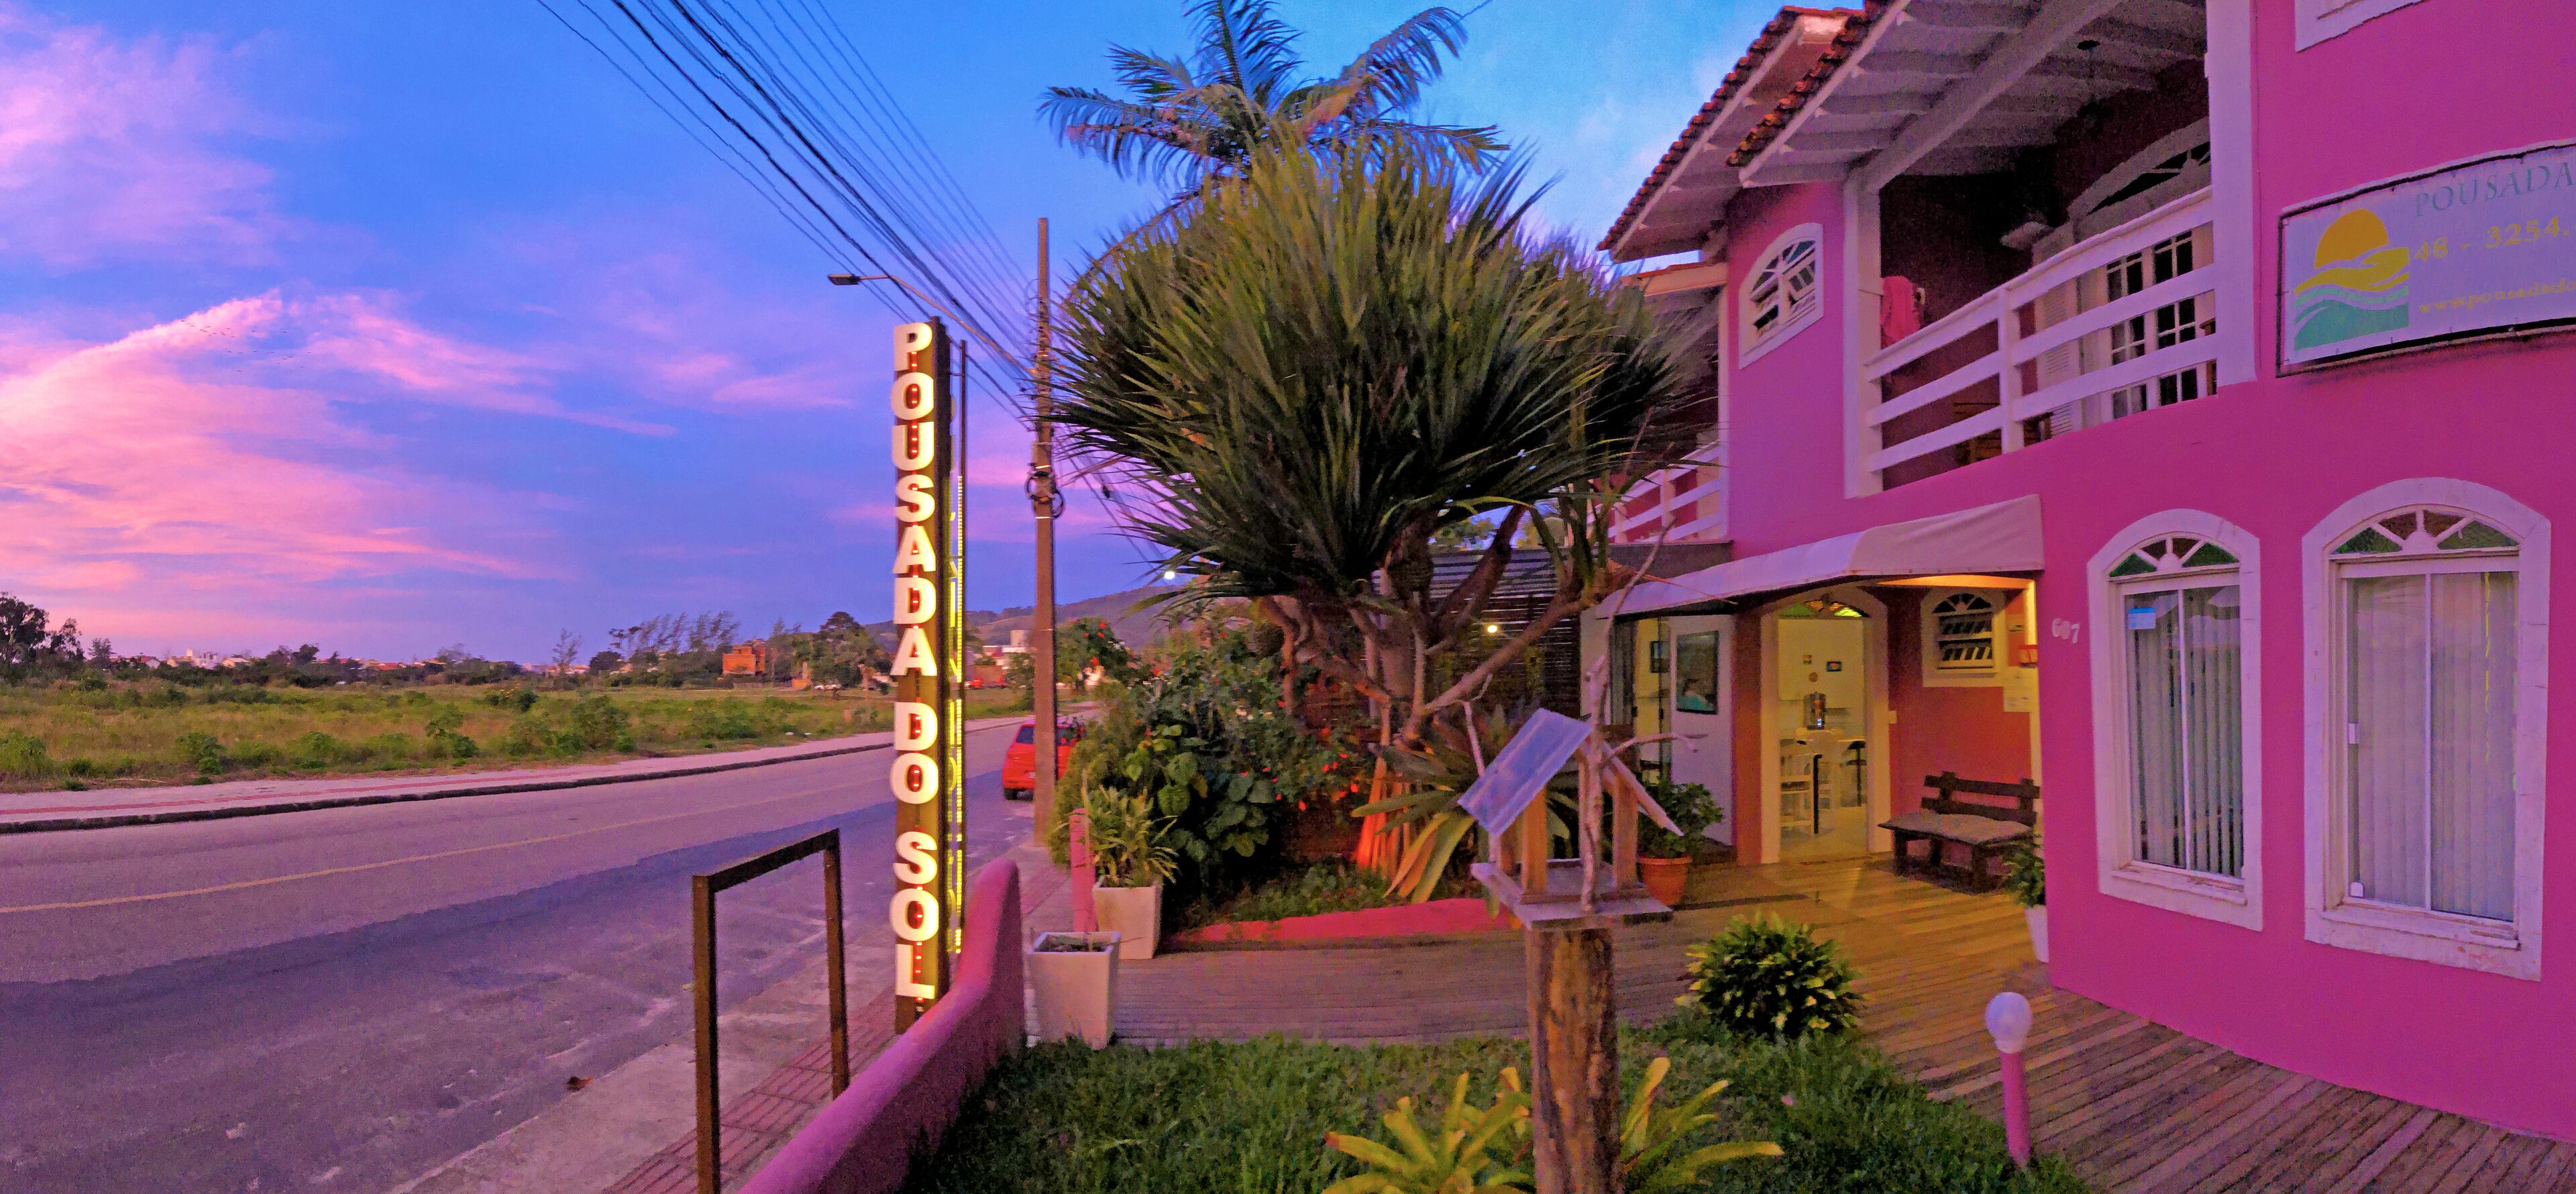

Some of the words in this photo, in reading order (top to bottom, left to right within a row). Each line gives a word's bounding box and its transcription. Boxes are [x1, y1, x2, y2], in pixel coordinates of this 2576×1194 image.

[2414, 236, 2448, 262] 48
[2485, 215, 2576, 250] 3254.
[890, 322, 937, 676] POUSADA
[2051, 618, 2080, 644] 607
[890, 702, 938, 804] DO
[890, 831, 939, 999] SOL
